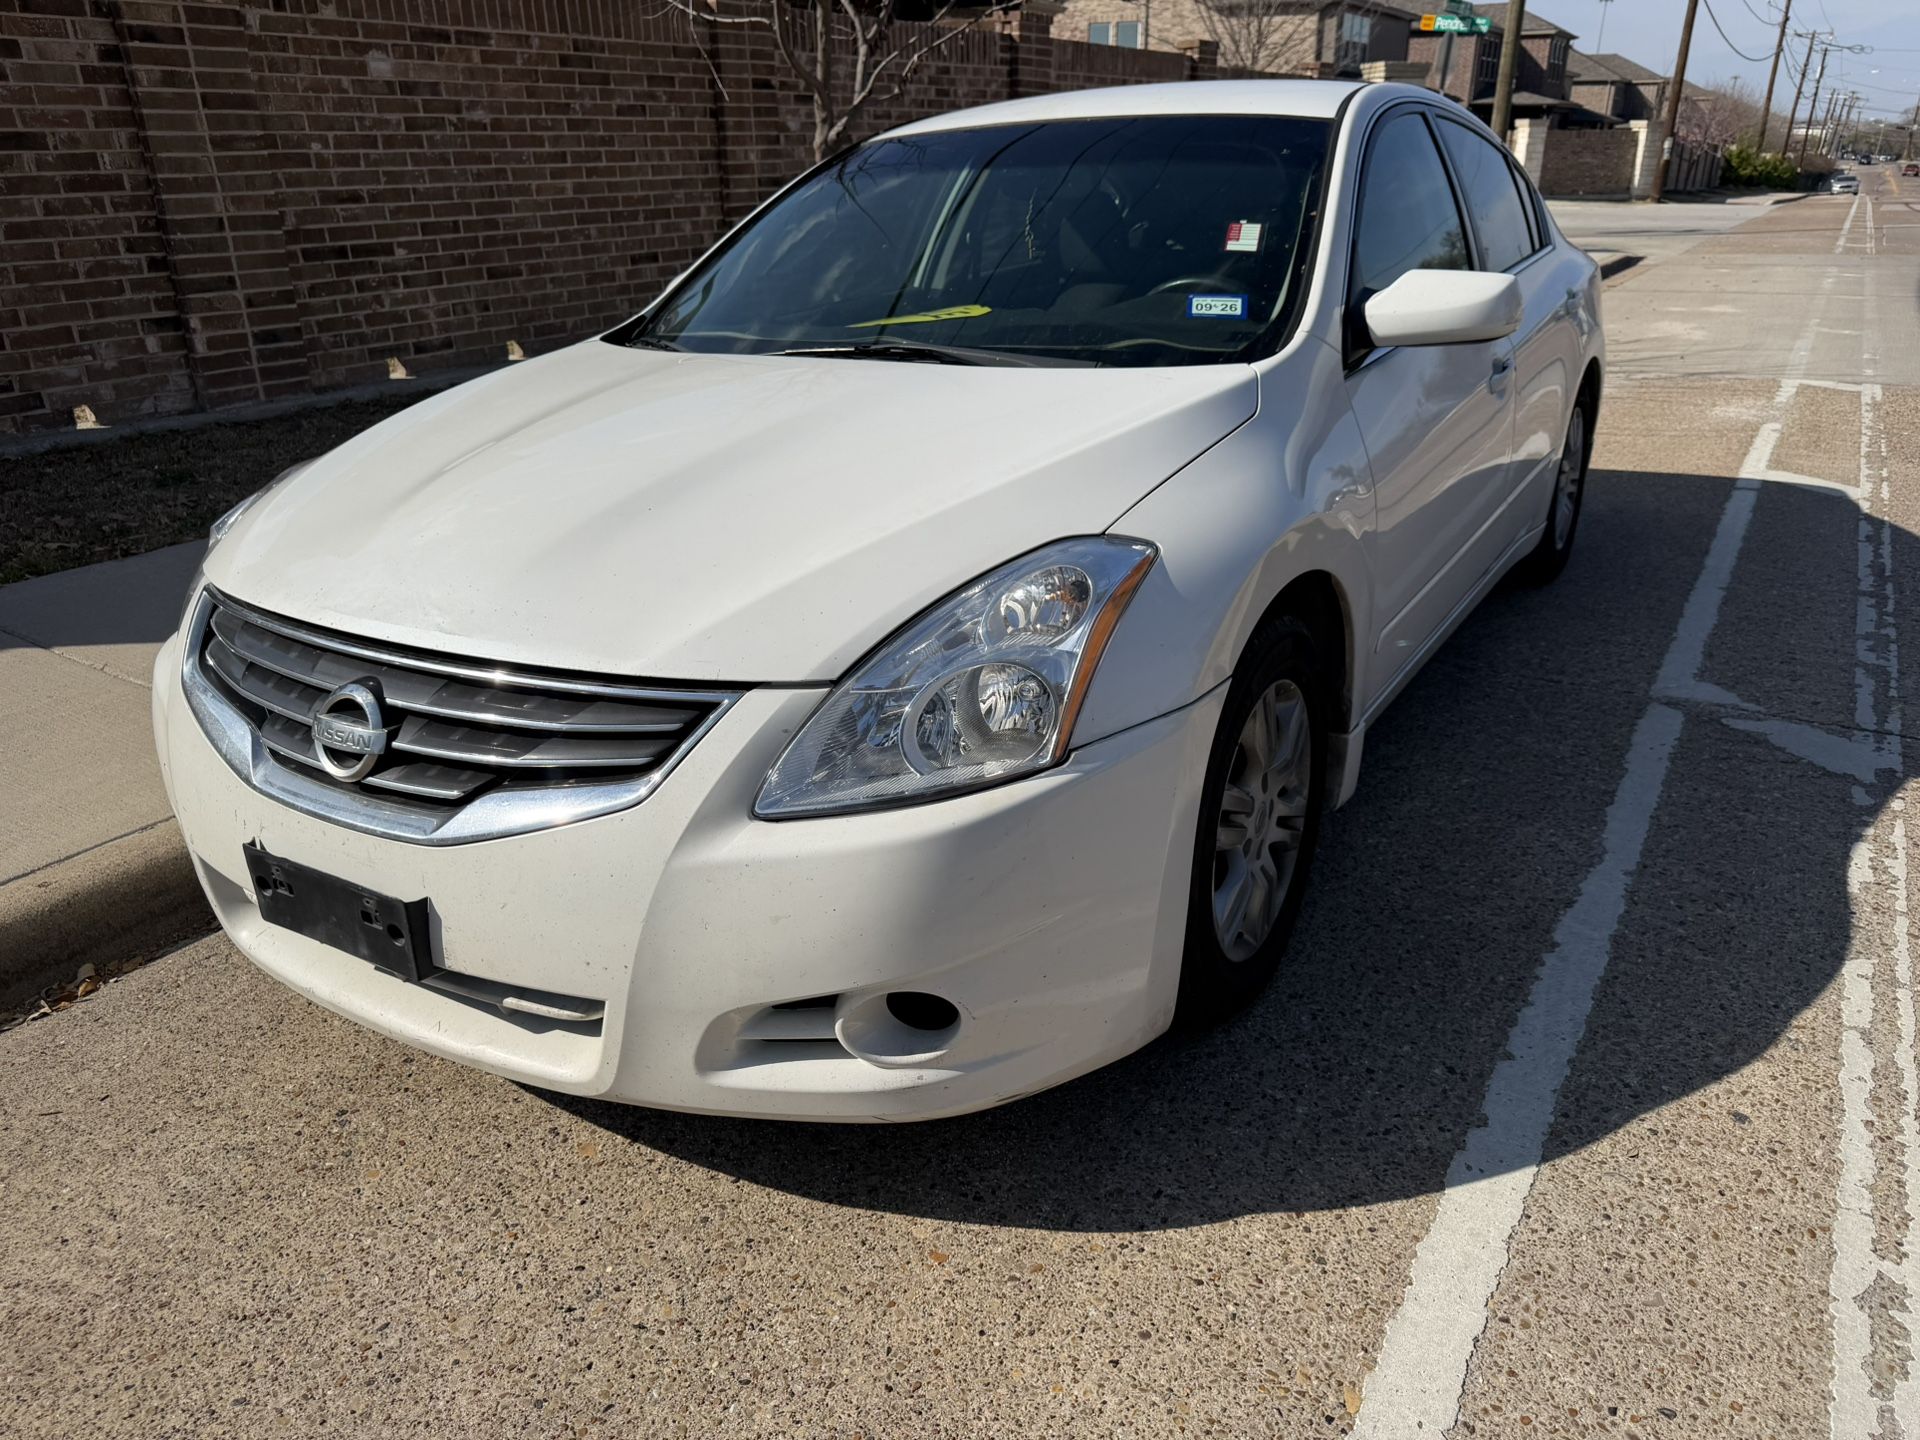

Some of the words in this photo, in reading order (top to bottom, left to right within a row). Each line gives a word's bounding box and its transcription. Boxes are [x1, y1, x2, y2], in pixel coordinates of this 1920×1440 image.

[1195, 303, 1212, 312] 09
[1220, 303, 1238, 312] 26
[314, 724, 372, 751] NISSAN
